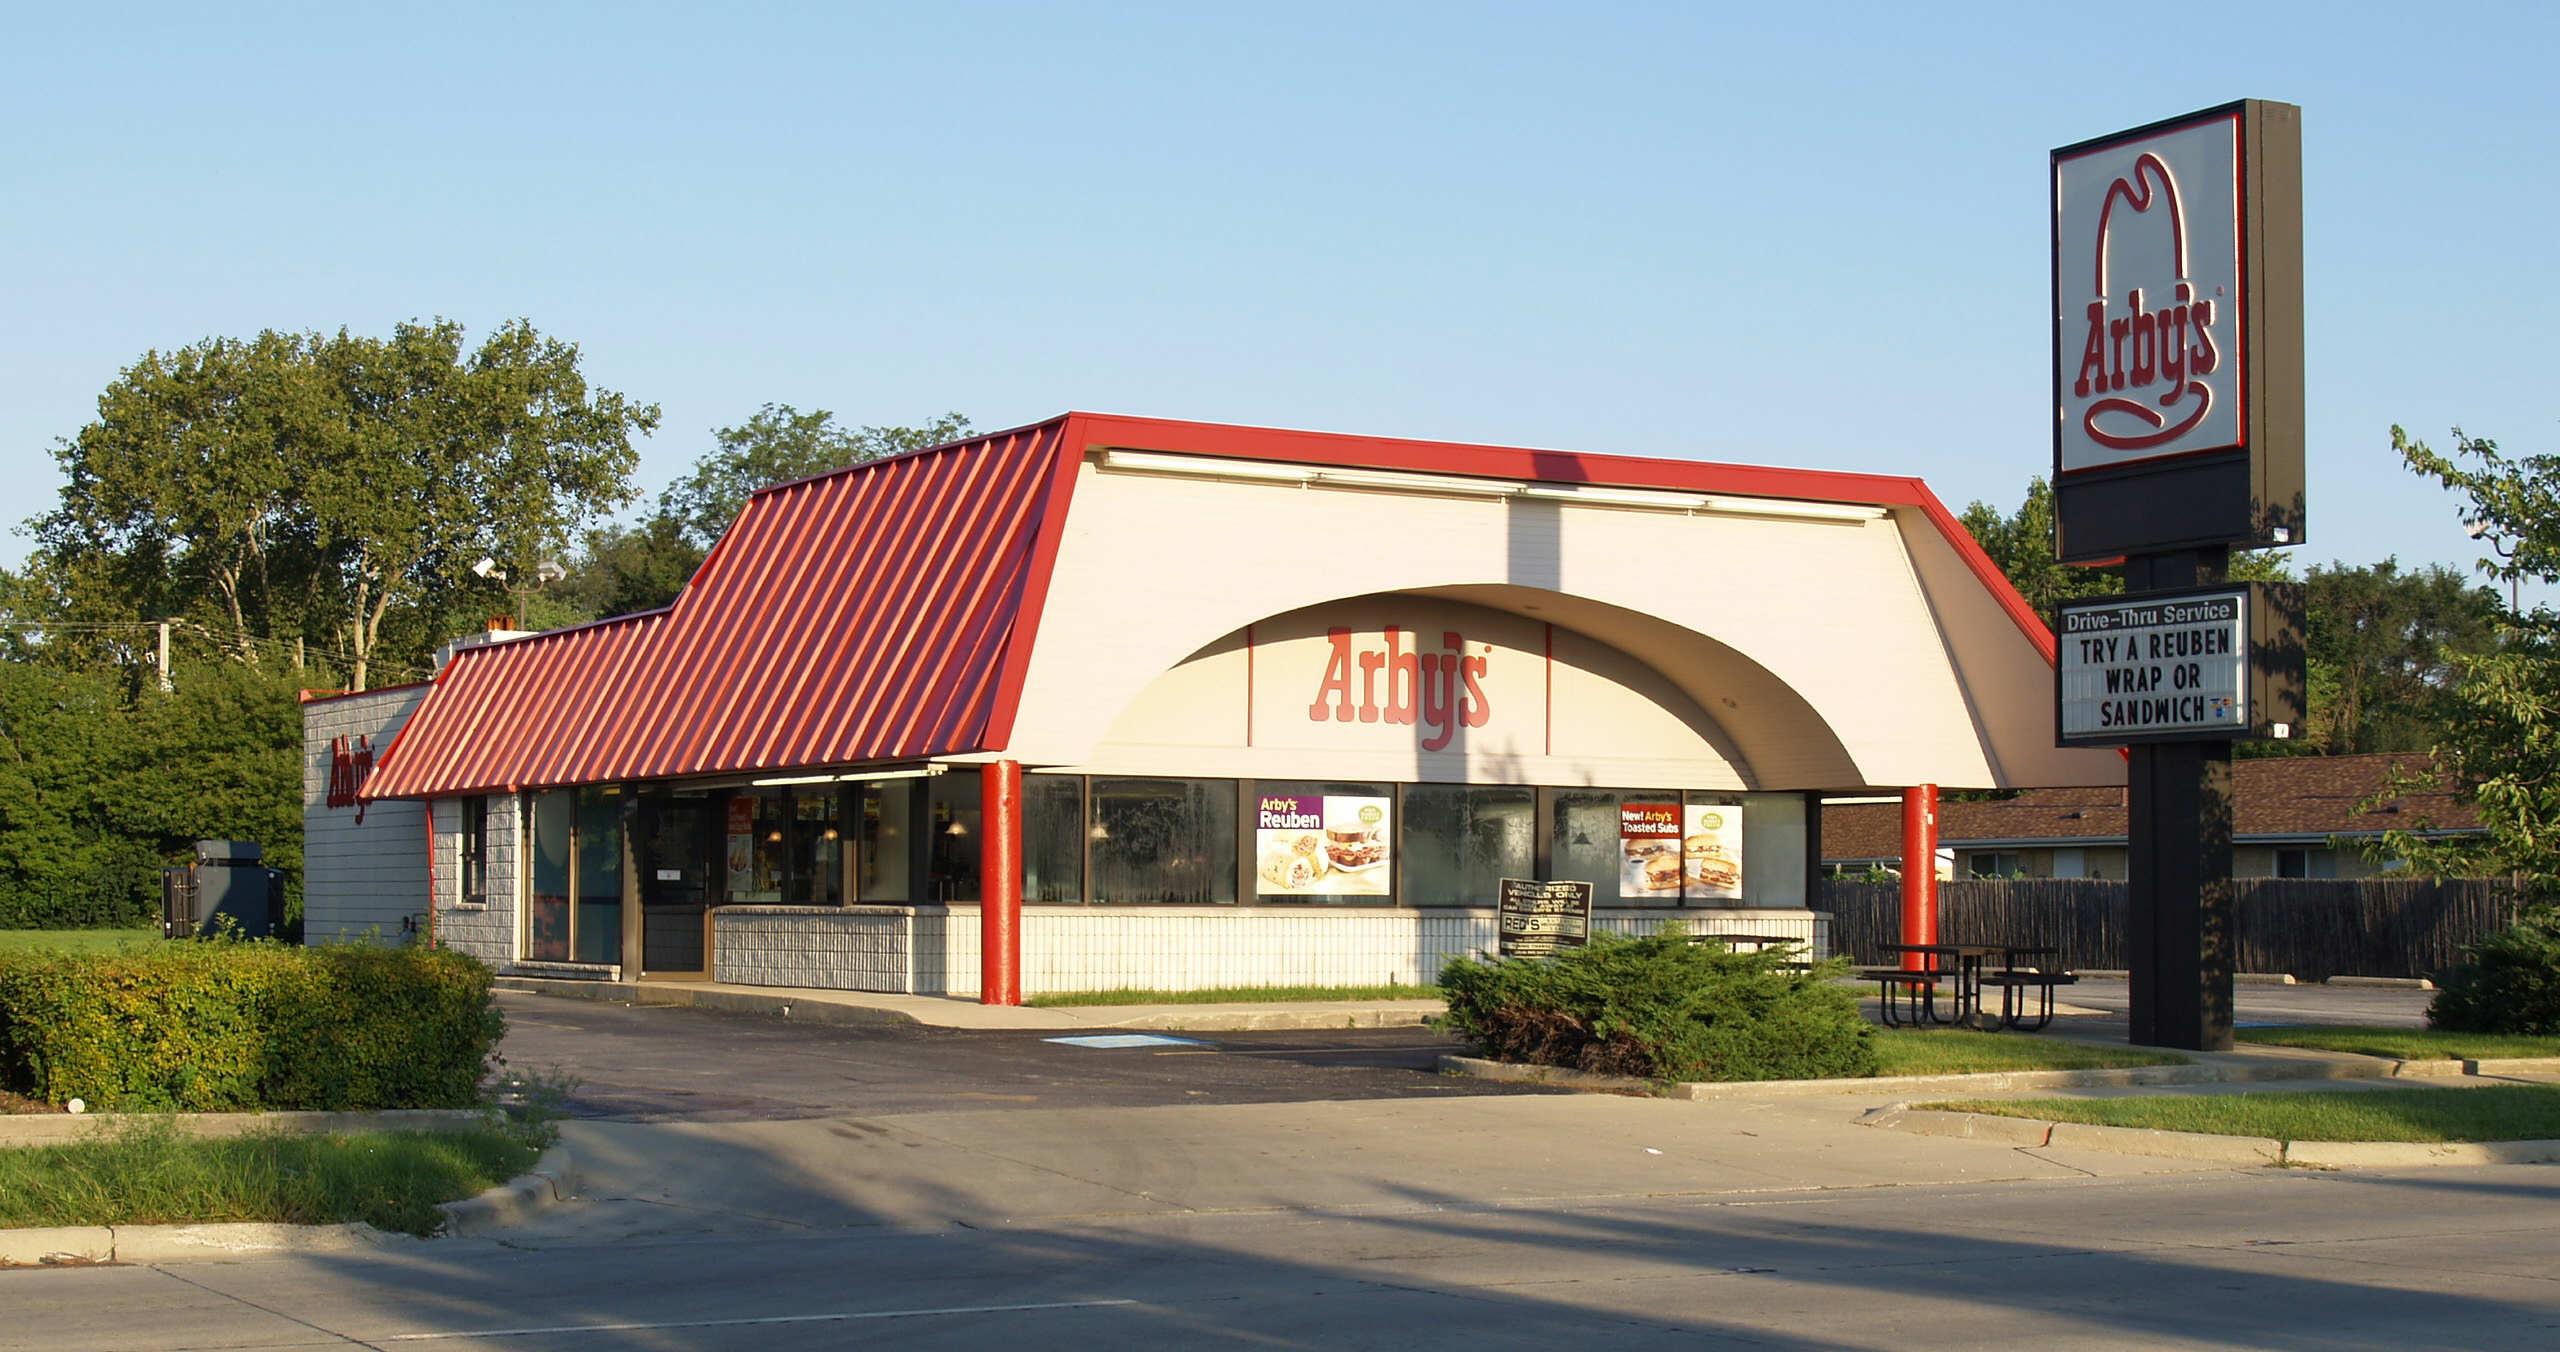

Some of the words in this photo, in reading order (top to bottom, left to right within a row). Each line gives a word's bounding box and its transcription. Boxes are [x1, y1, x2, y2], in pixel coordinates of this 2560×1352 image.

[2074, 283, 2219, 406] Arby's
[2067, 608, 2157, 632] Drive-Thru
[2164, 601, 2230, 625] Service
[2080, 637, 2118, 664] TRY
[2126, 635, 2138, 661] A
[2150, 628, 2229, 660] REUBEN
[1309, 625, 1490, 752] Arby's
[2106, 666, 2162, 694] WRAP
[2174, 663, 2201, 690] OR
[2101, 696, 2205, 727] SANDWICH
[1260, 811, 1320, 829] Reuben
[1261, 798, 1298, 812] Arby's
[1622, 811, 1644, 821] New!
[1645, 811, 1672, 823] Arby's
[1622, 822, 1656, 833] Toasted
[1658, 823, 1679, 833] Subs
[1505, 917, 1540, 930] RED'S
